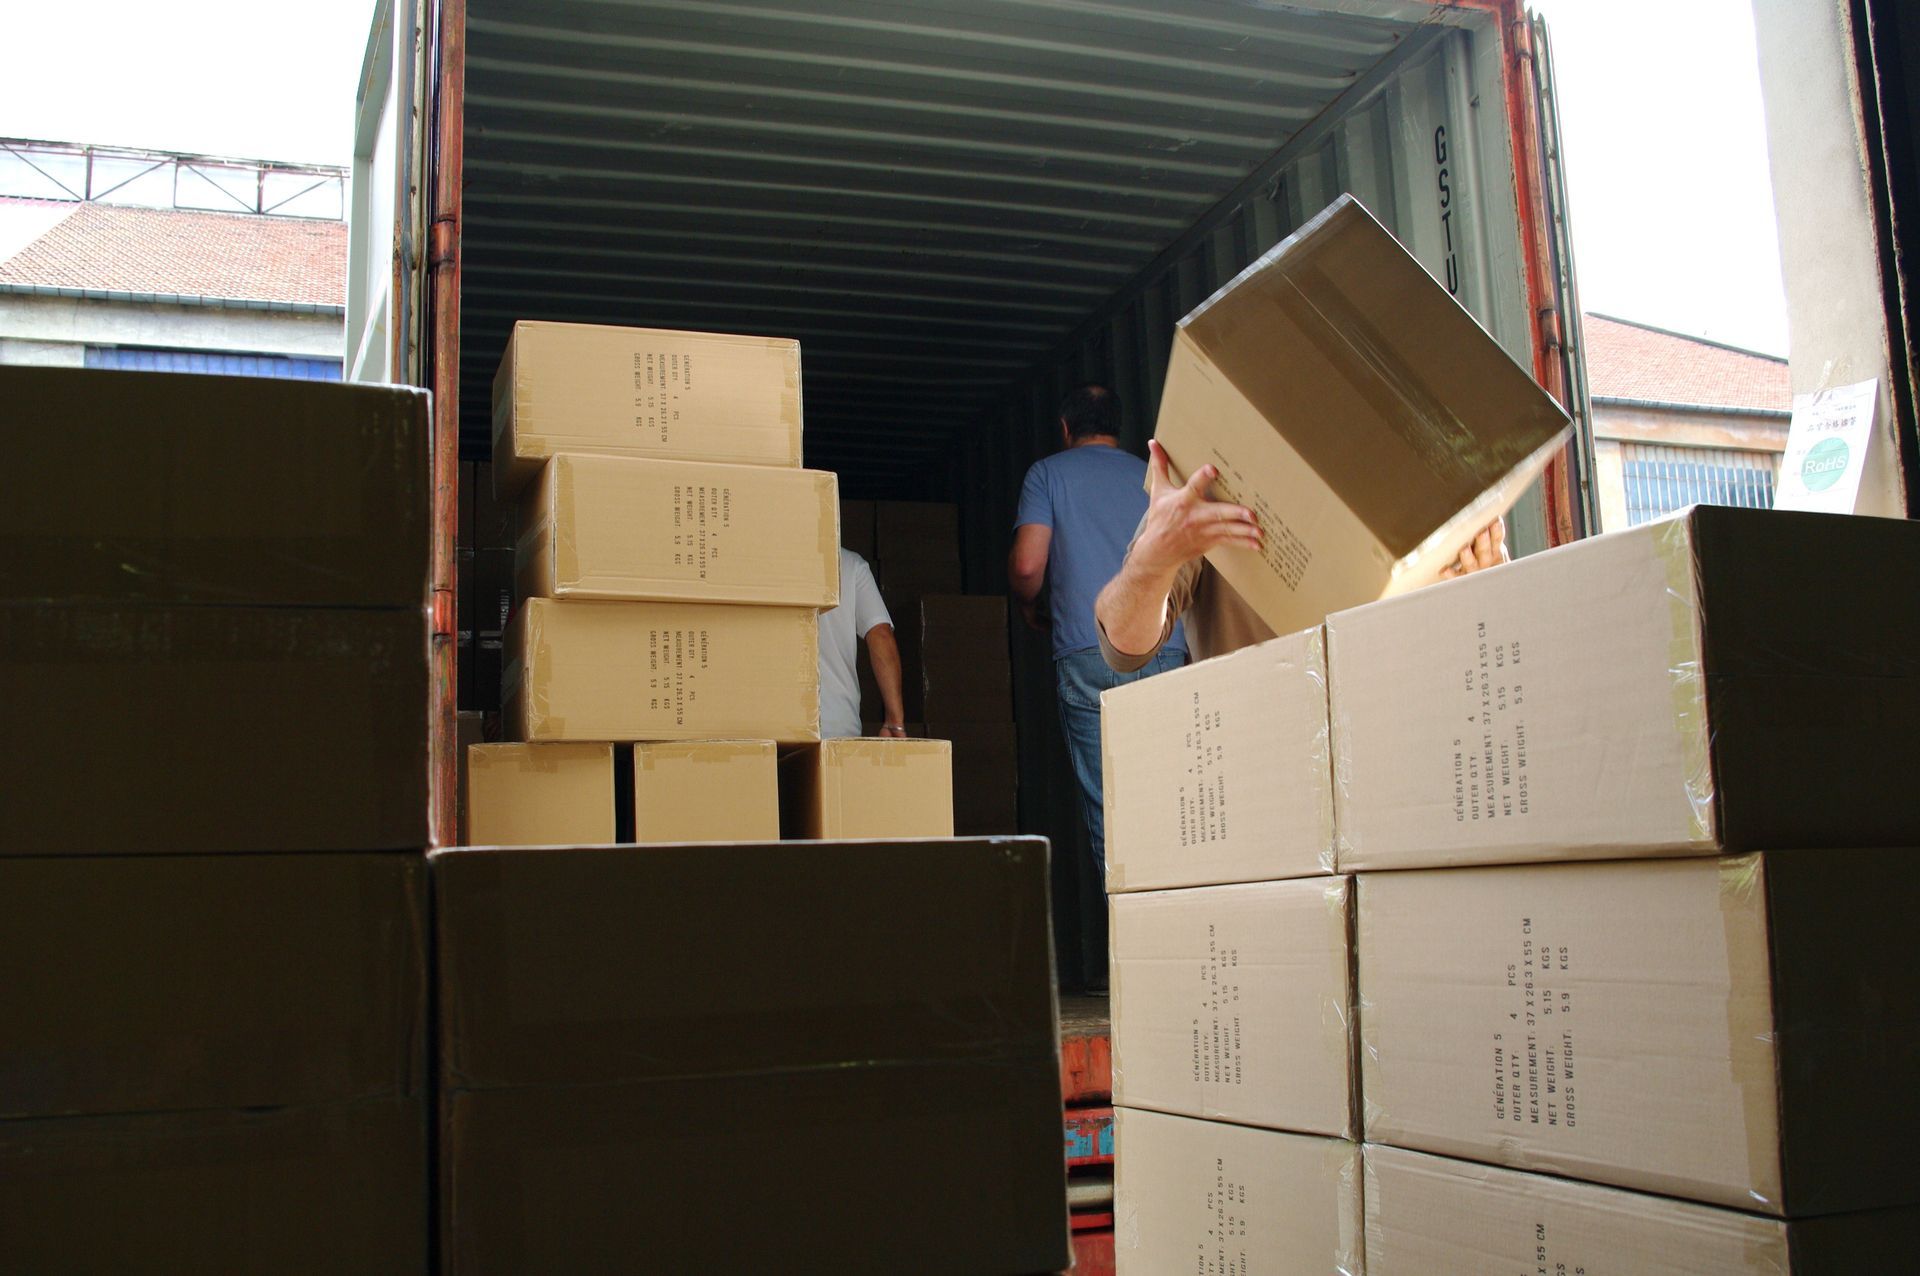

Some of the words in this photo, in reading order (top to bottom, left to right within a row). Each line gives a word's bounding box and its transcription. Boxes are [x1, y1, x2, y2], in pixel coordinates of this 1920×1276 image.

[1434, 125, 1458, 296] GSTU
[1804, 455, 1846, 474] RoHS
[1477, 622, 1486, 638] CM
[1478, 643, 1487, 658] 55
[1496, 645, 1504, 668] KGS
[1512, 641, 1521, 664] KGS
[1465, 669, 1473, 691] PCS
[1480, 673, 1490, 697] 26.3
[1194, 691, 1199, 704] CM
[1498, 686, 1506, 710] 5.15
[1514, 685, 1523, 704] 5.9
[1194, 707, 1200, 719] 55
[1482, 712, 1491, 725] 37
[1197, 764, 1203, 775] 37
[1453, 752, 1464, 822] GÉNÉRATION
[1519, 775, 1528, 814] GROSS
[1470, 784, 1480, 820] OUTER
[1502, 794, 1511, 816] NET
[1209, 924, 1215, 937] CM
[1523, 918, 1531, 934] CM
[1210, 940, 1215, 952] 55
[1523, 940, 1532, 956] 55
[1541, 946, 1550, 970] KGS
[1559, 946, 1568, 970] KGS
[1508, 964, 1516, 986] PCS
[1525, 971, 1534, 997] 26.3
[1212, 1001, 1218, 1012] 37
[1544, 990, 1552, 1015] 5.15
[1561, 992, 1571, 1013] 5.9
[1526, 1012, 1535, 1026] 37
[1192, 1029, 1200, 1081] GÉNÉRATION
[1512, 1050, 1520, 1078] QTY:
[1563, 1028, 1574, 1079] WEIGHT:
[1528, 1030, 1539, 1124] MEASUREMENT:
[1546, 1045, 1556, 1094] WEIGHT:
[1493, 1048, 1505, 1120] GÉNÉRATION
[1512, 1084, 1521, 1121] OUTER
[1565, 1087, 1575, 1127] GROSS
[1548, 1102, 1557, 1126] NET
[1217, 1158, 1222, 1171] CM
[1217, 1176, 1223, 1188] 55
[1218, 1231, 1224, 1243] 37
[1536, 1224, 1545, 1241] CM
[1537, 1246, 1545, 1261] 55
